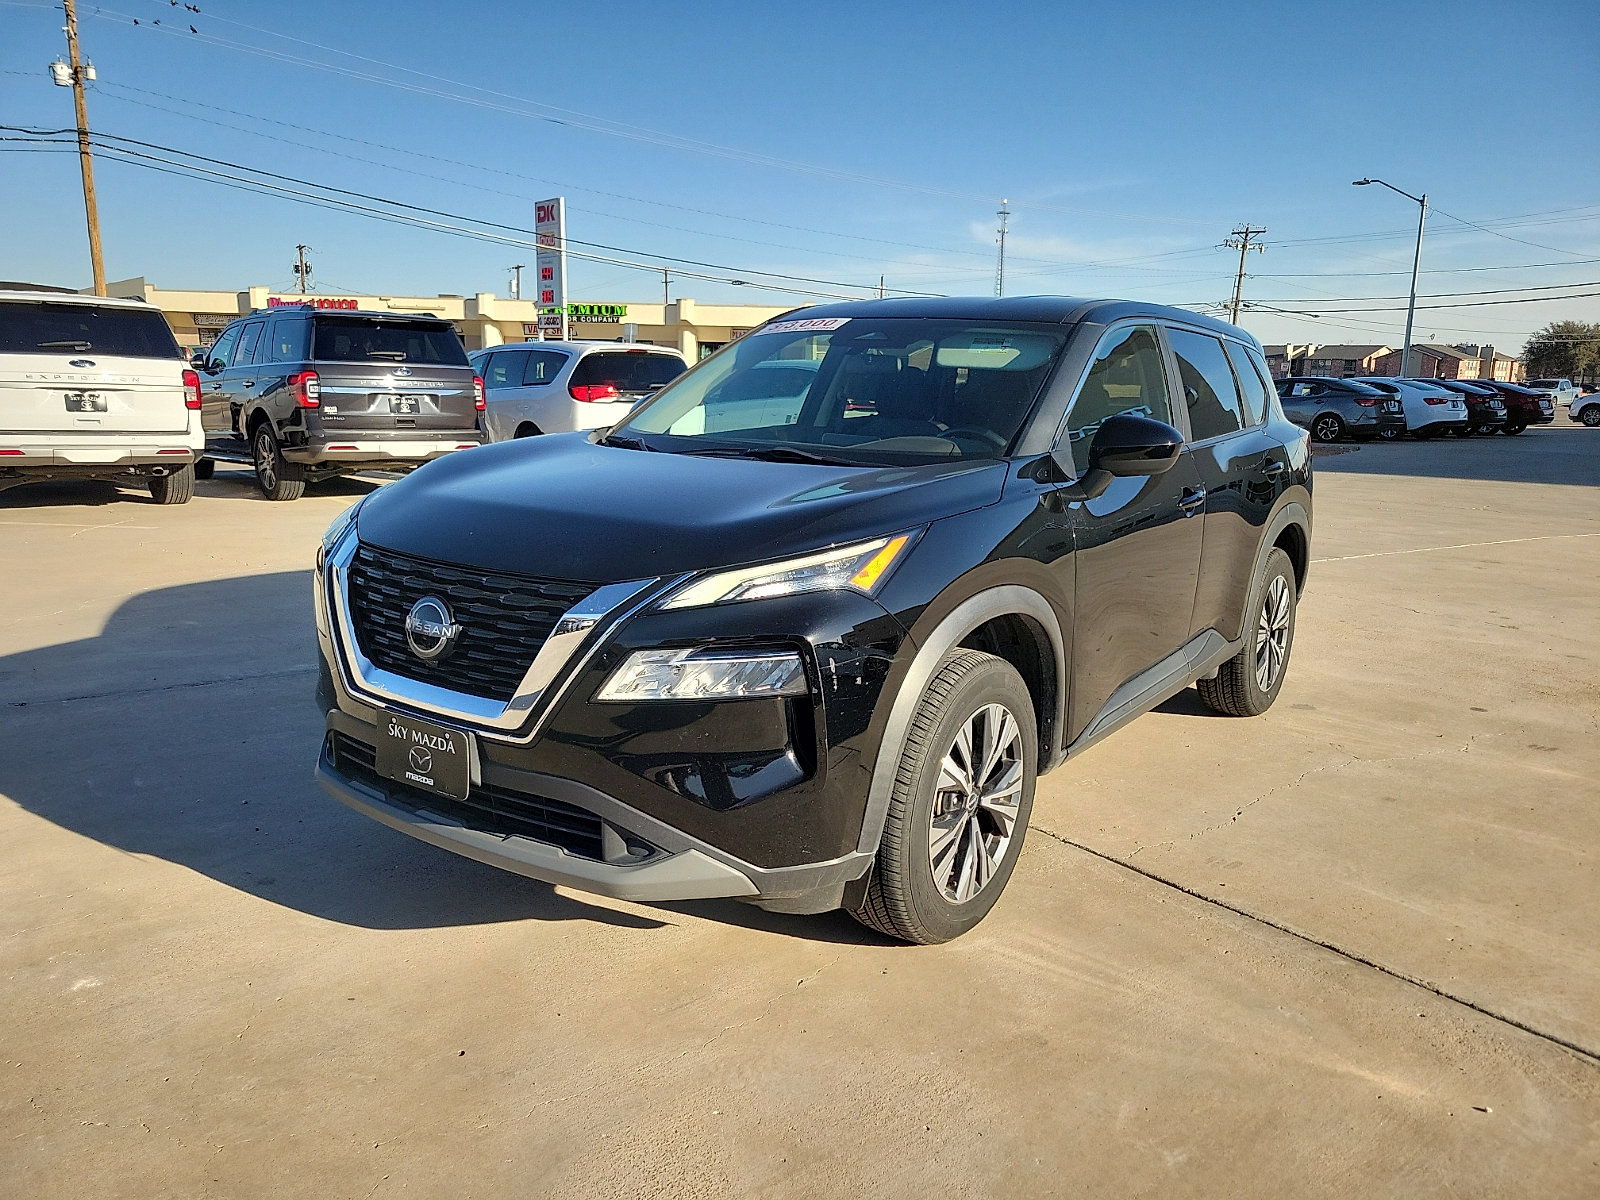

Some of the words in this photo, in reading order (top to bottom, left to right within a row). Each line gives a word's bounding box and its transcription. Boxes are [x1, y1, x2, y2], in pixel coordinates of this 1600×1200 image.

[537, 205, 555, 223] DK
[407, 617, 455, 638] NISSAN
[388, 723, 409, 740] SKY
[411, 729, 456, 755] MAZDA
[405, 771, 434, 786] mazda
